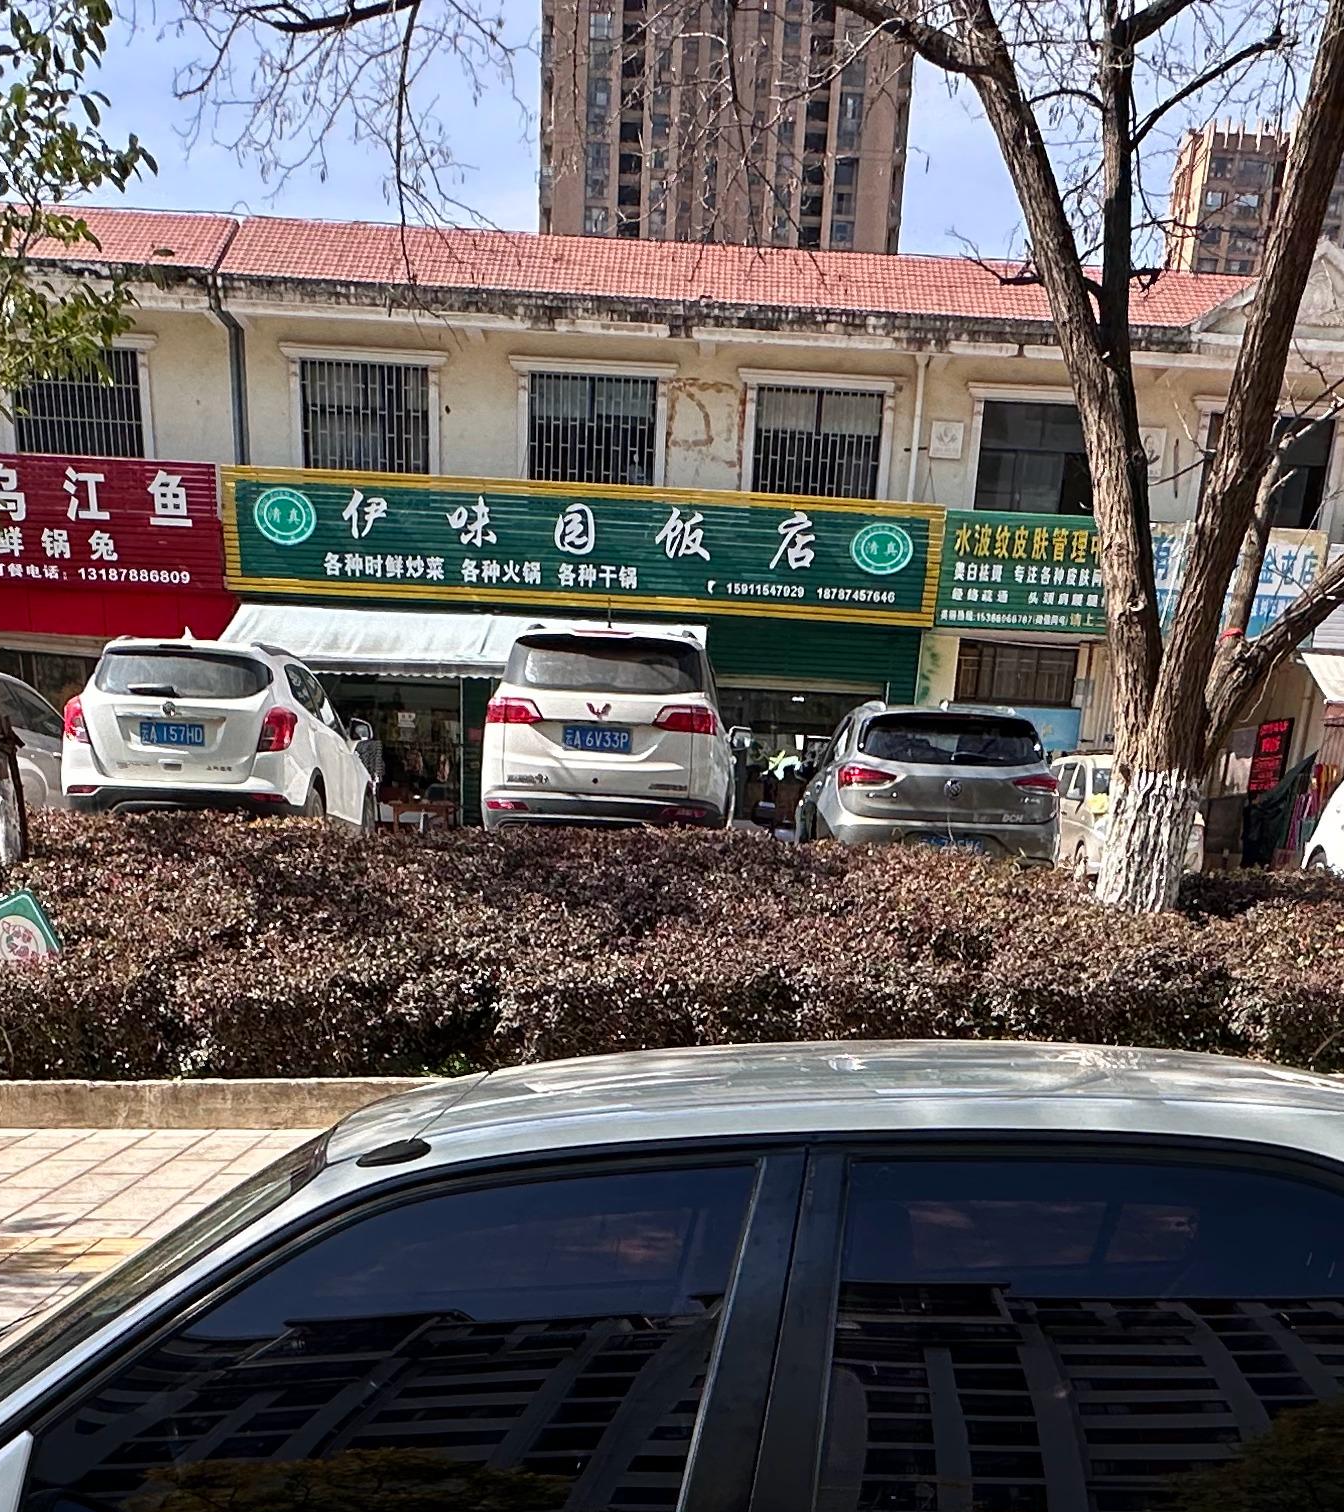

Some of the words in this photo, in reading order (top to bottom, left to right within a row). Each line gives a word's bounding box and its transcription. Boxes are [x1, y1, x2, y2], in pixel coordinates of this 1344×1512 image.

[323, 552, 445, 581] 各种时鲜炒菜
[460, 558, 541, 585] 各种火锅
[557, 563, 638, 590] 各种干锅
